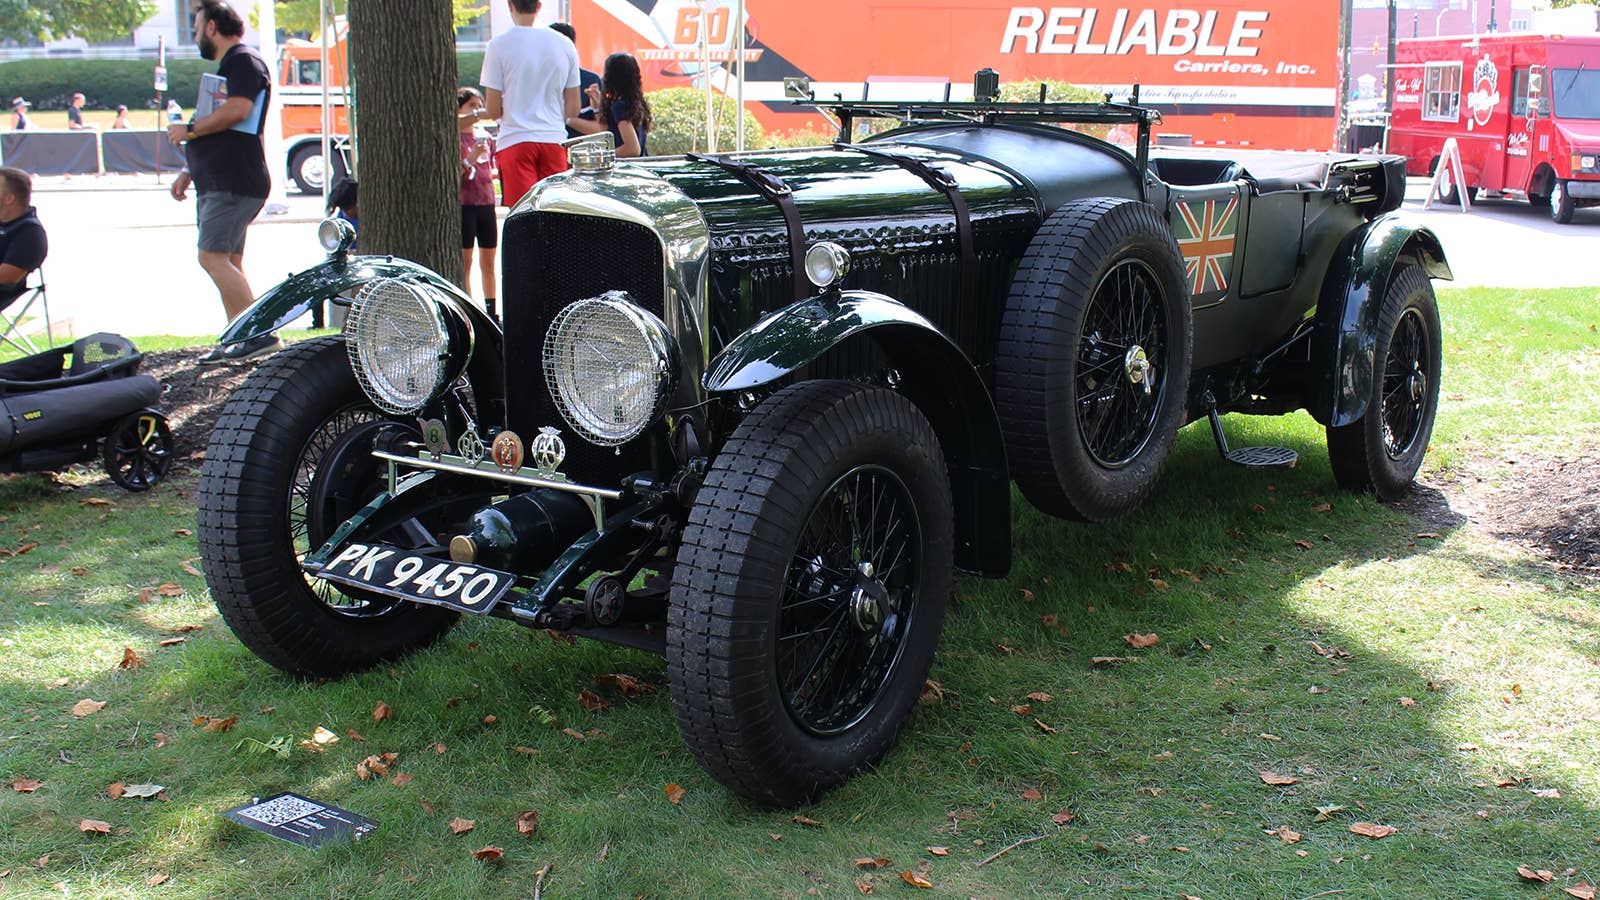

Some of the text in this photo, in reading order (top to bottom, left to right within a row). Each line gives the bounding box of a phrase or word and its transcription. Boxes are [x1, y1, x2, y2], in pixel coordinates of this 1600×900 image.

[673, 7, 729, 45] 60
[1000, 7, 1270, 56] RELIABLE
[1174, 60, 1316, 76] Carriers, Inc.
[326, 544, 498, 605] PK 9450
